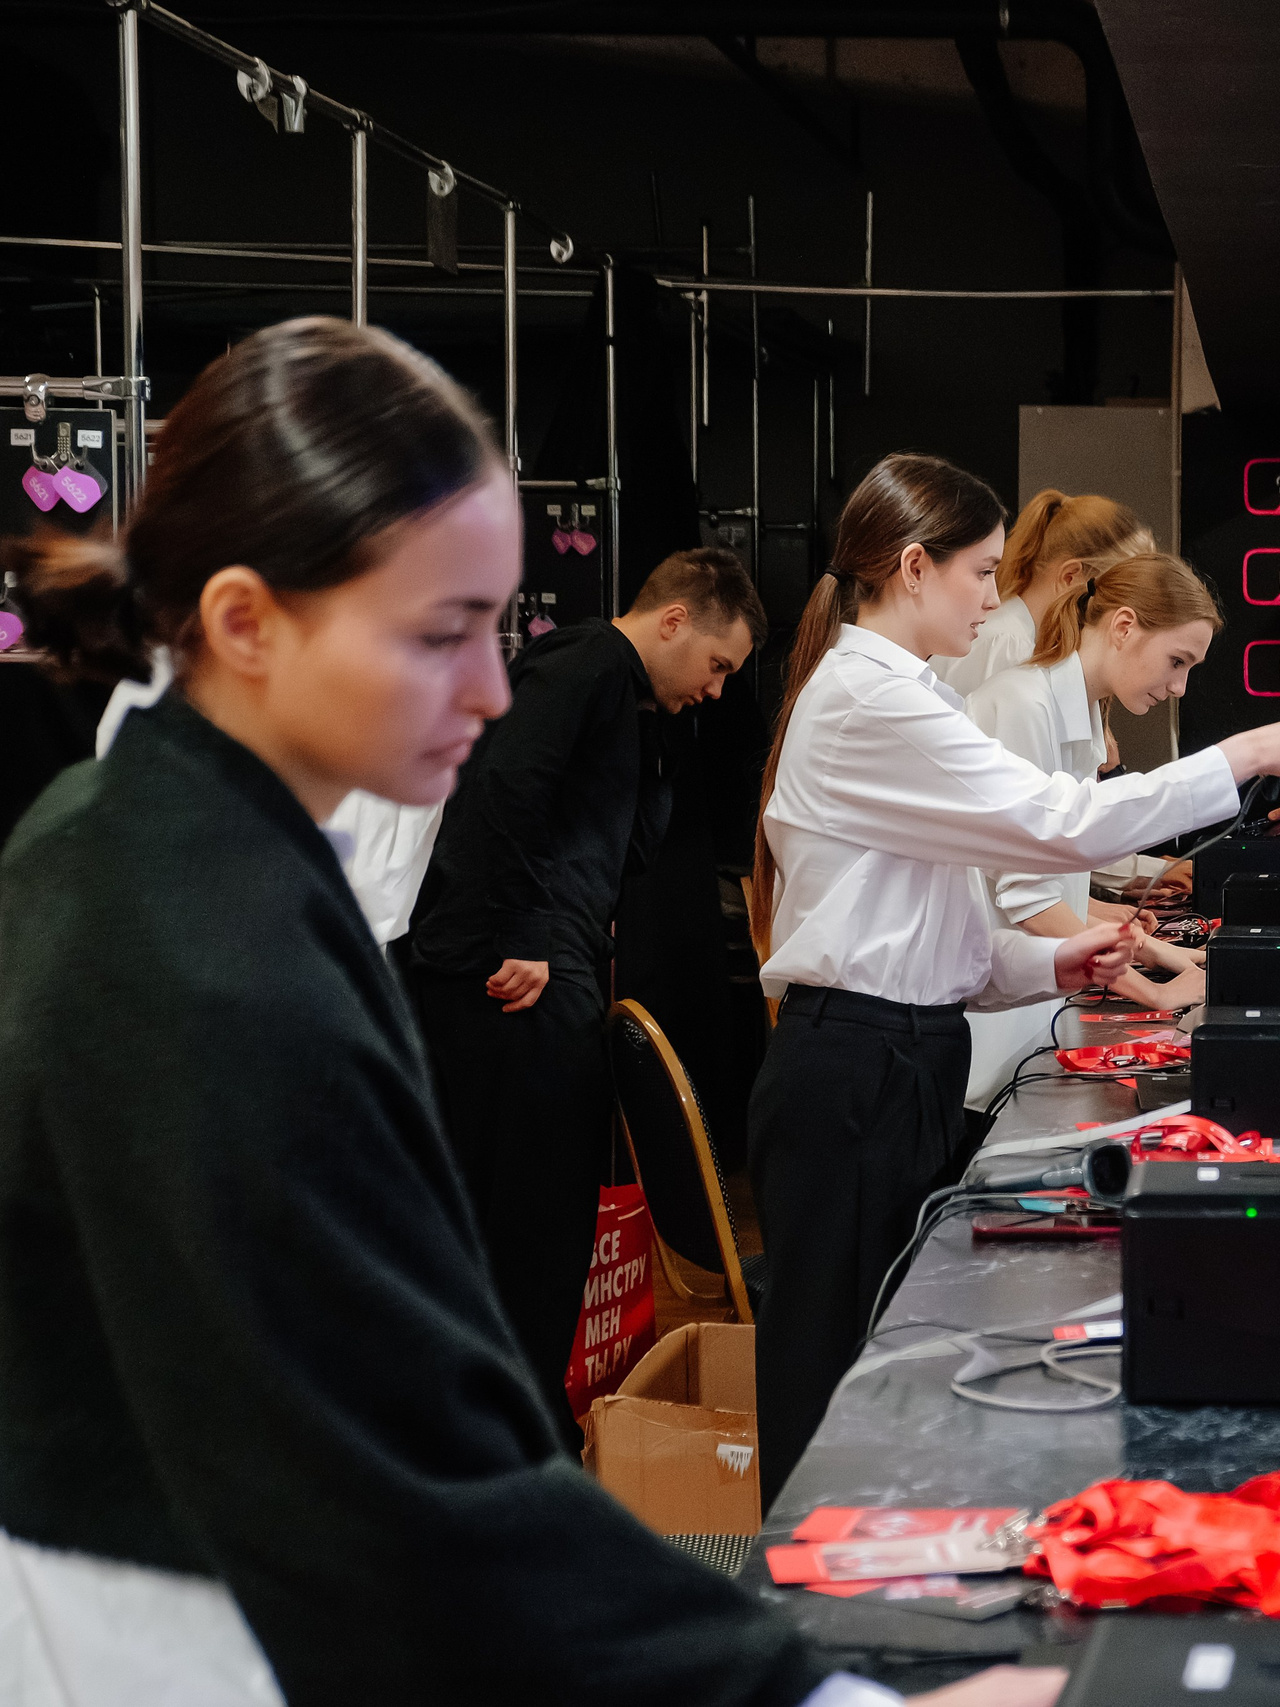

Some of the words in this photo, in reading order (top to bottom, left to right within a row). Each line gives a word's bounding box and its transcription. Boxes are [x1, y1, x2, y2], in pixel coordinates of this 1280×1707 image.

[81, 434, 101, 442] 5622
[29, 477, 49, 501] 5621
[61, 476, 87, 504] 5622
[583, 1253, 647, 1310] ИНСТРУ
[584, 1304, 621, 1350] МЕН
[584, 1334, 633, 1387] ТЫ.РУ
